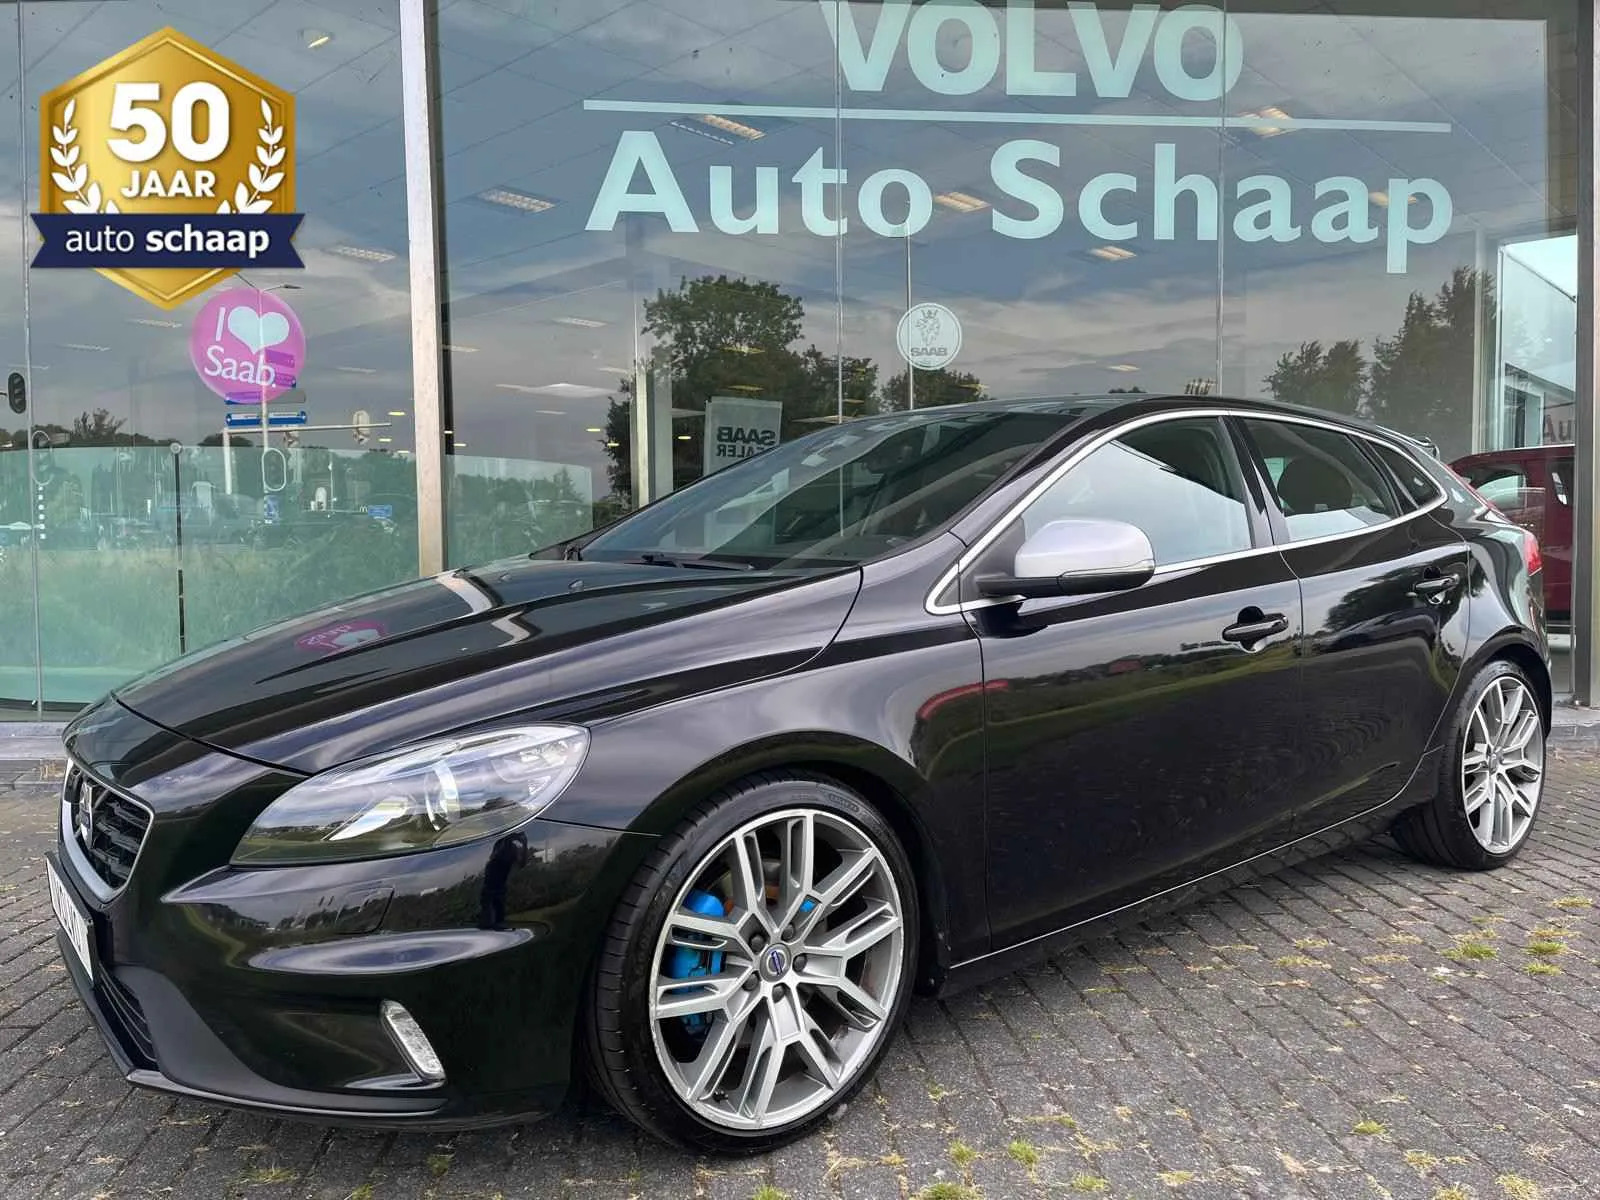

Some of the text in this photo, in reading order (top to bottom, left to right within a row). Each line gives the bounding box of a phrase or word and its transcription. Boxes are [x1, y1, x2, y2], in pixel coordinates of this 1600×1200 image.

[820, 0, 1243, 101] VOLVO
[585, 130, 1454, 274] Auto Schaap
[910, 347, 948, 357] SAAB
